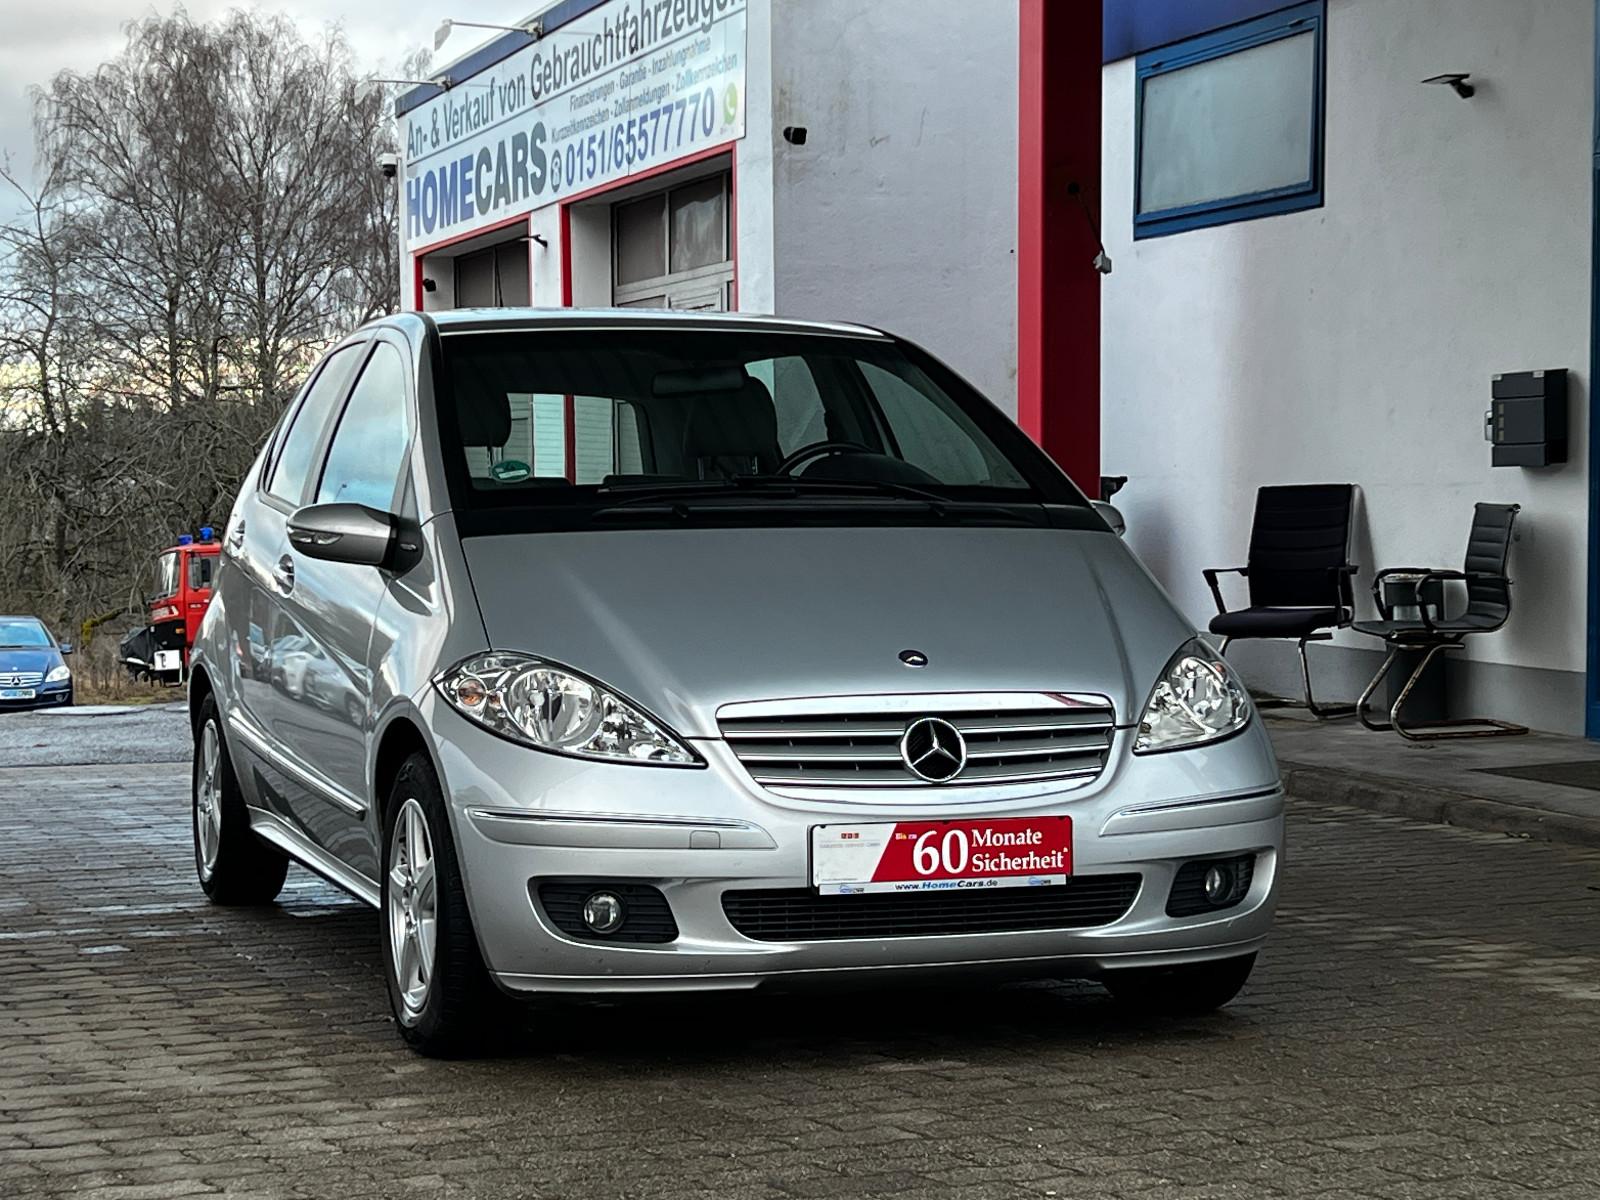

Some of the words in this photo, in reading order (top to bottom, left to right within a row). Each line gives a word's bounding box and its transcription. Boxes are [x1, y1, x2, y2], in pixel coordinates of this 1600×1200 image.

[406, 119, 427, 160] An-
[430, 107, 440, 149] &
[443, 76, 495, 142] Verkauf
[499, 73, 525, 116] von
[531, 0, 742, 100] Gebrauchtfahrzeug
[619, 64, 647, 90] Garantie
[407, 121, 547, 240] HOMECARS
[565, 87, 715, 187] 0151/65577770
[913, 829, 969, 875] 60
[971, 828, 1042, 847] Monate
[895, 879, 998, 890] www.HomeCars.de
